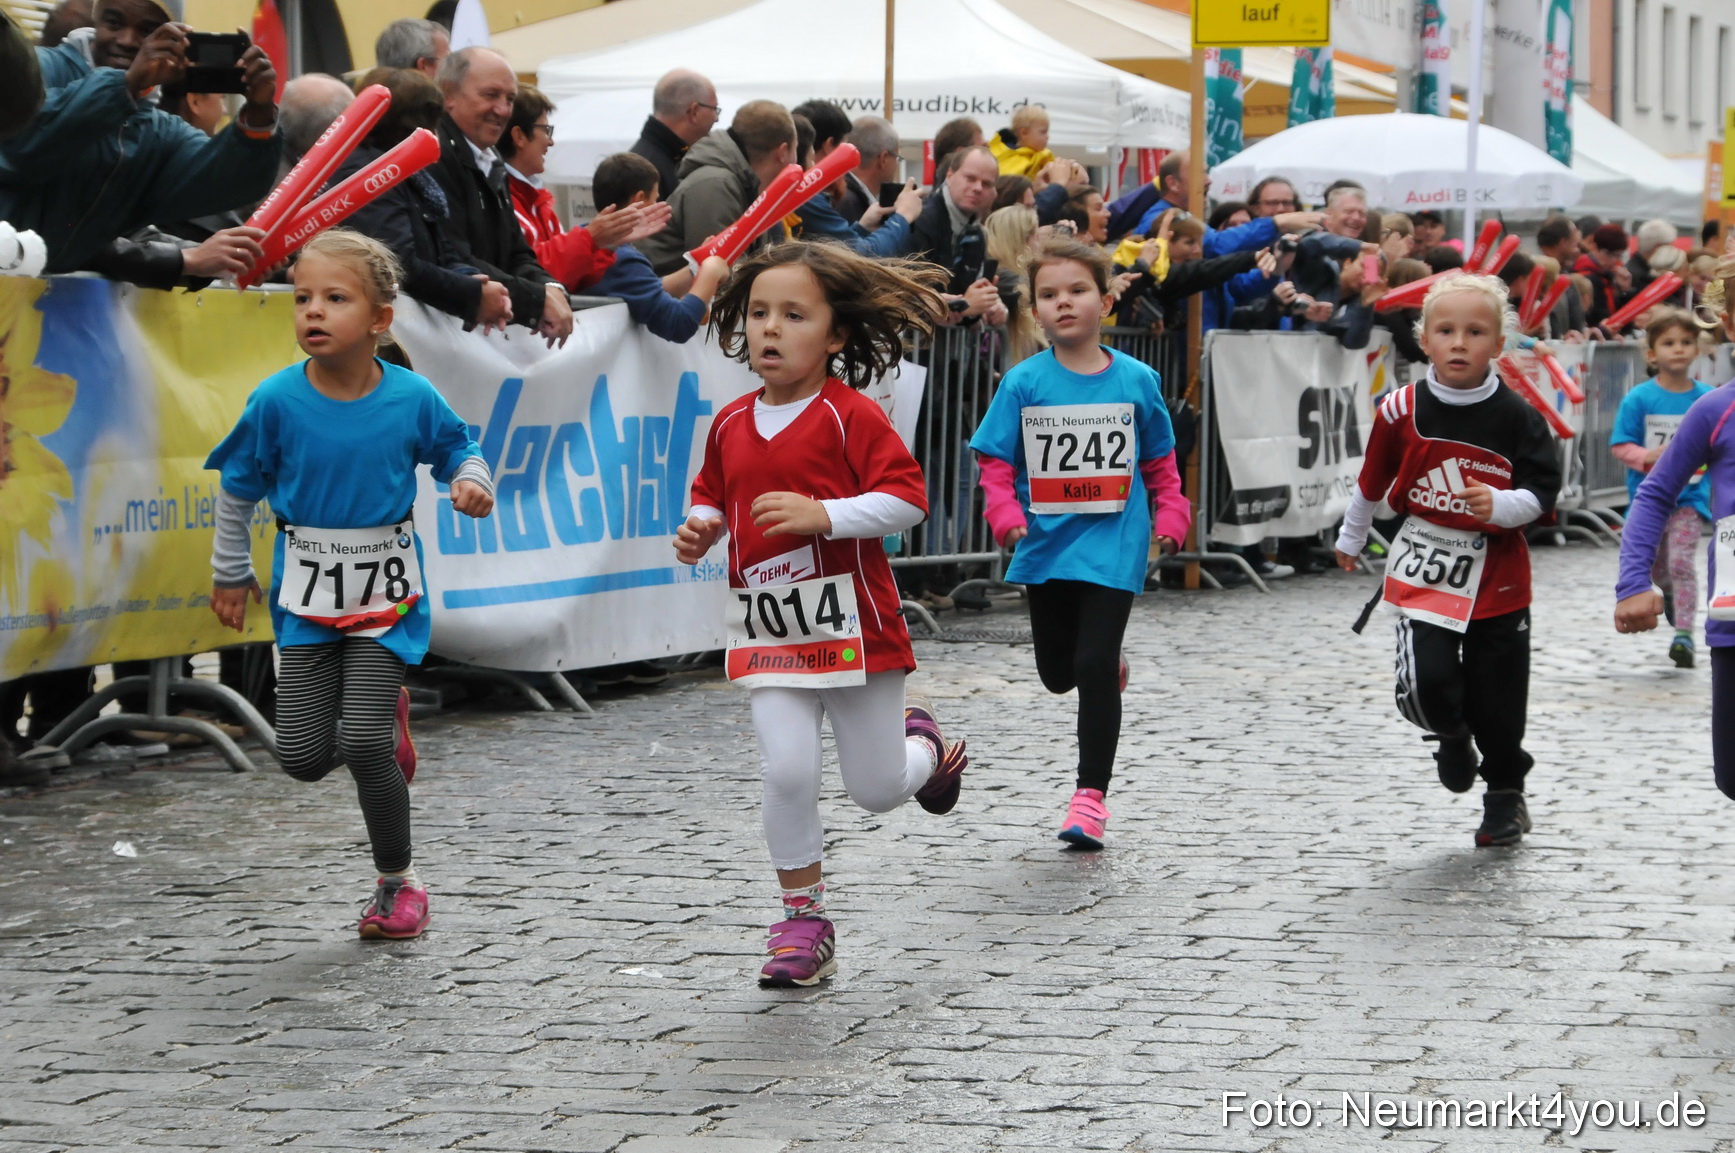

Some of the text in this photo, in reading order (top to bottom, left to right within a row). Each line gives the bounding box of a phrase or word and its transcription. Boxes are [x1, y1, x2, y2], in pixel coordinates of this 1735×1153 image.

[1241, 4, 1280, 22] lauf
[252, 157, 309, 221] Audi BKK
[1405, 188, 1451, 204] Audi
[283, 193, 355, 248] Audi BKK
[1025, 415, 1117, 428] PARTL Neumarkt
[1036, 430, 1127, 472] 7242
[1458, 457, 1512, 480] FC Holzheim
[1063, 481, 1102, 500] Katja
[289, 537, 393, 555] PARTL Neumarkt
[1417, 528, 1468, 549] Neumarkt
[759, 561, 791, 584] DEHN
[1393, 536, 1475, 589] 7550
[299, 556, 411, 610] 7178
[738, 582, 846, 640] 7014
[746, 647, 837, 670] Annabelle
